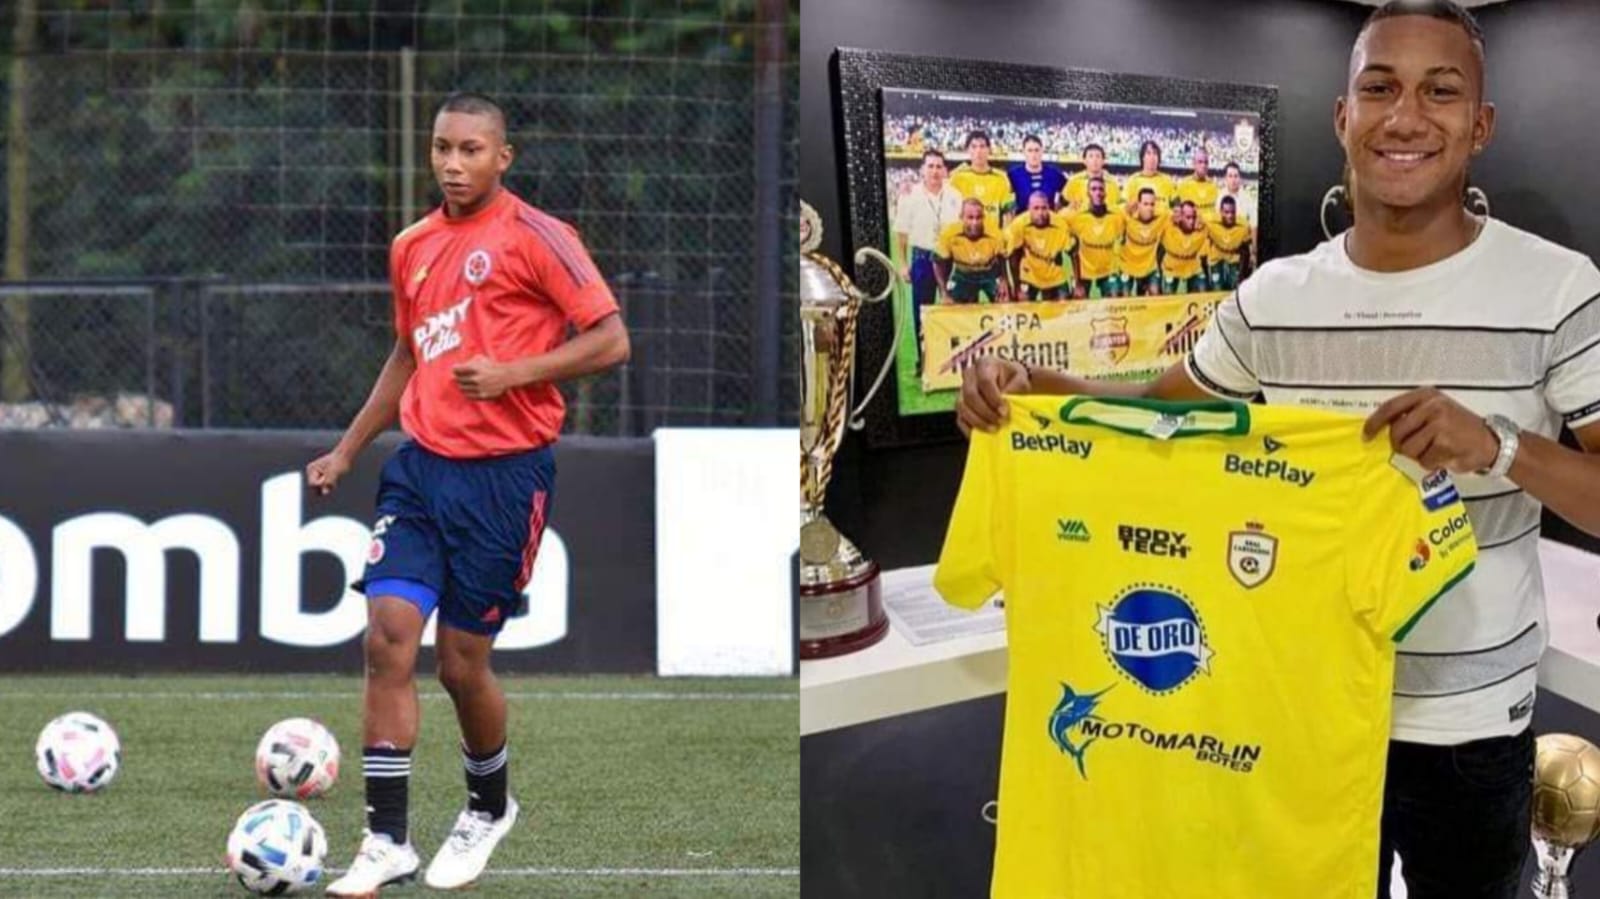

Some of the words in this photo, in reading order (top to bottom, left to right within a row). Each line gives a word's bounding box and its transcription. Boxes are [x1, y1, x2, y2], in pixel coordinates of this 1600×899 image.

[1011, 431, 1092, 460] BetPlay
[1224, 453, 1316, 488] BetPlay
[1118, 524, 1187, 545] BODY
[1120, 538, 1188, 559] TECH
[1114, 626, 1143, 652] DE
[1147, 621, 1195, 652] ORO
[1081, 719, 1261, 761] MOTOMARLIN
[1195, 750, 1253, 773] BOTES
